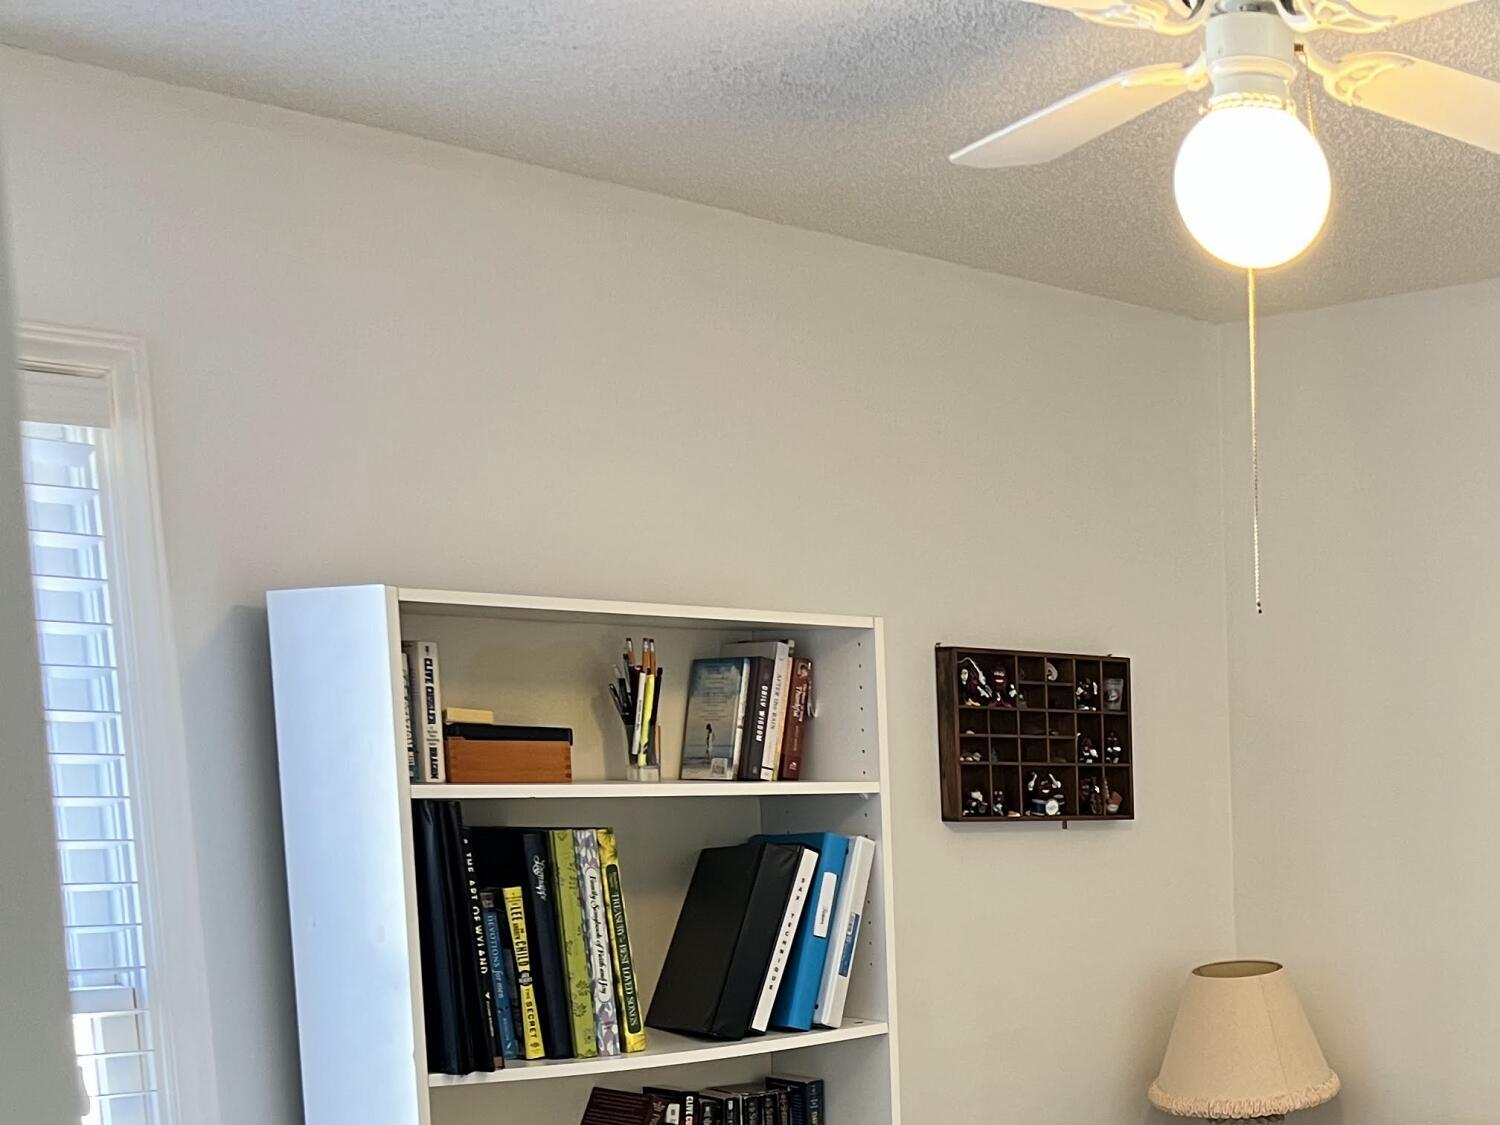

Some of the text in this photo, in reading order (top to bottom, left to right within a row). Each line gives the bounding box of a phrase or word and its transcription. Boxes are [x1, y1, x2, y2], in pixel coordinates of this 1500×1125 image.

[756, 710, 765, 742] WISDOM
[465, 852, 488, 975] THE ART OF WYLAND
[510, 906, 522, 921] LEE
[486, 915, 499, 968] DEVOTIONS
[514, 940, 528, 967] CHILD
[618, 943, 630, 964] BEST
[621, 966, 635, 994] LOVED
[526, 1001, 537, 1038] SECRET
[627, 996, 638, 1027] SONGS
[685, 1096, 694, 1114] CLIVE
